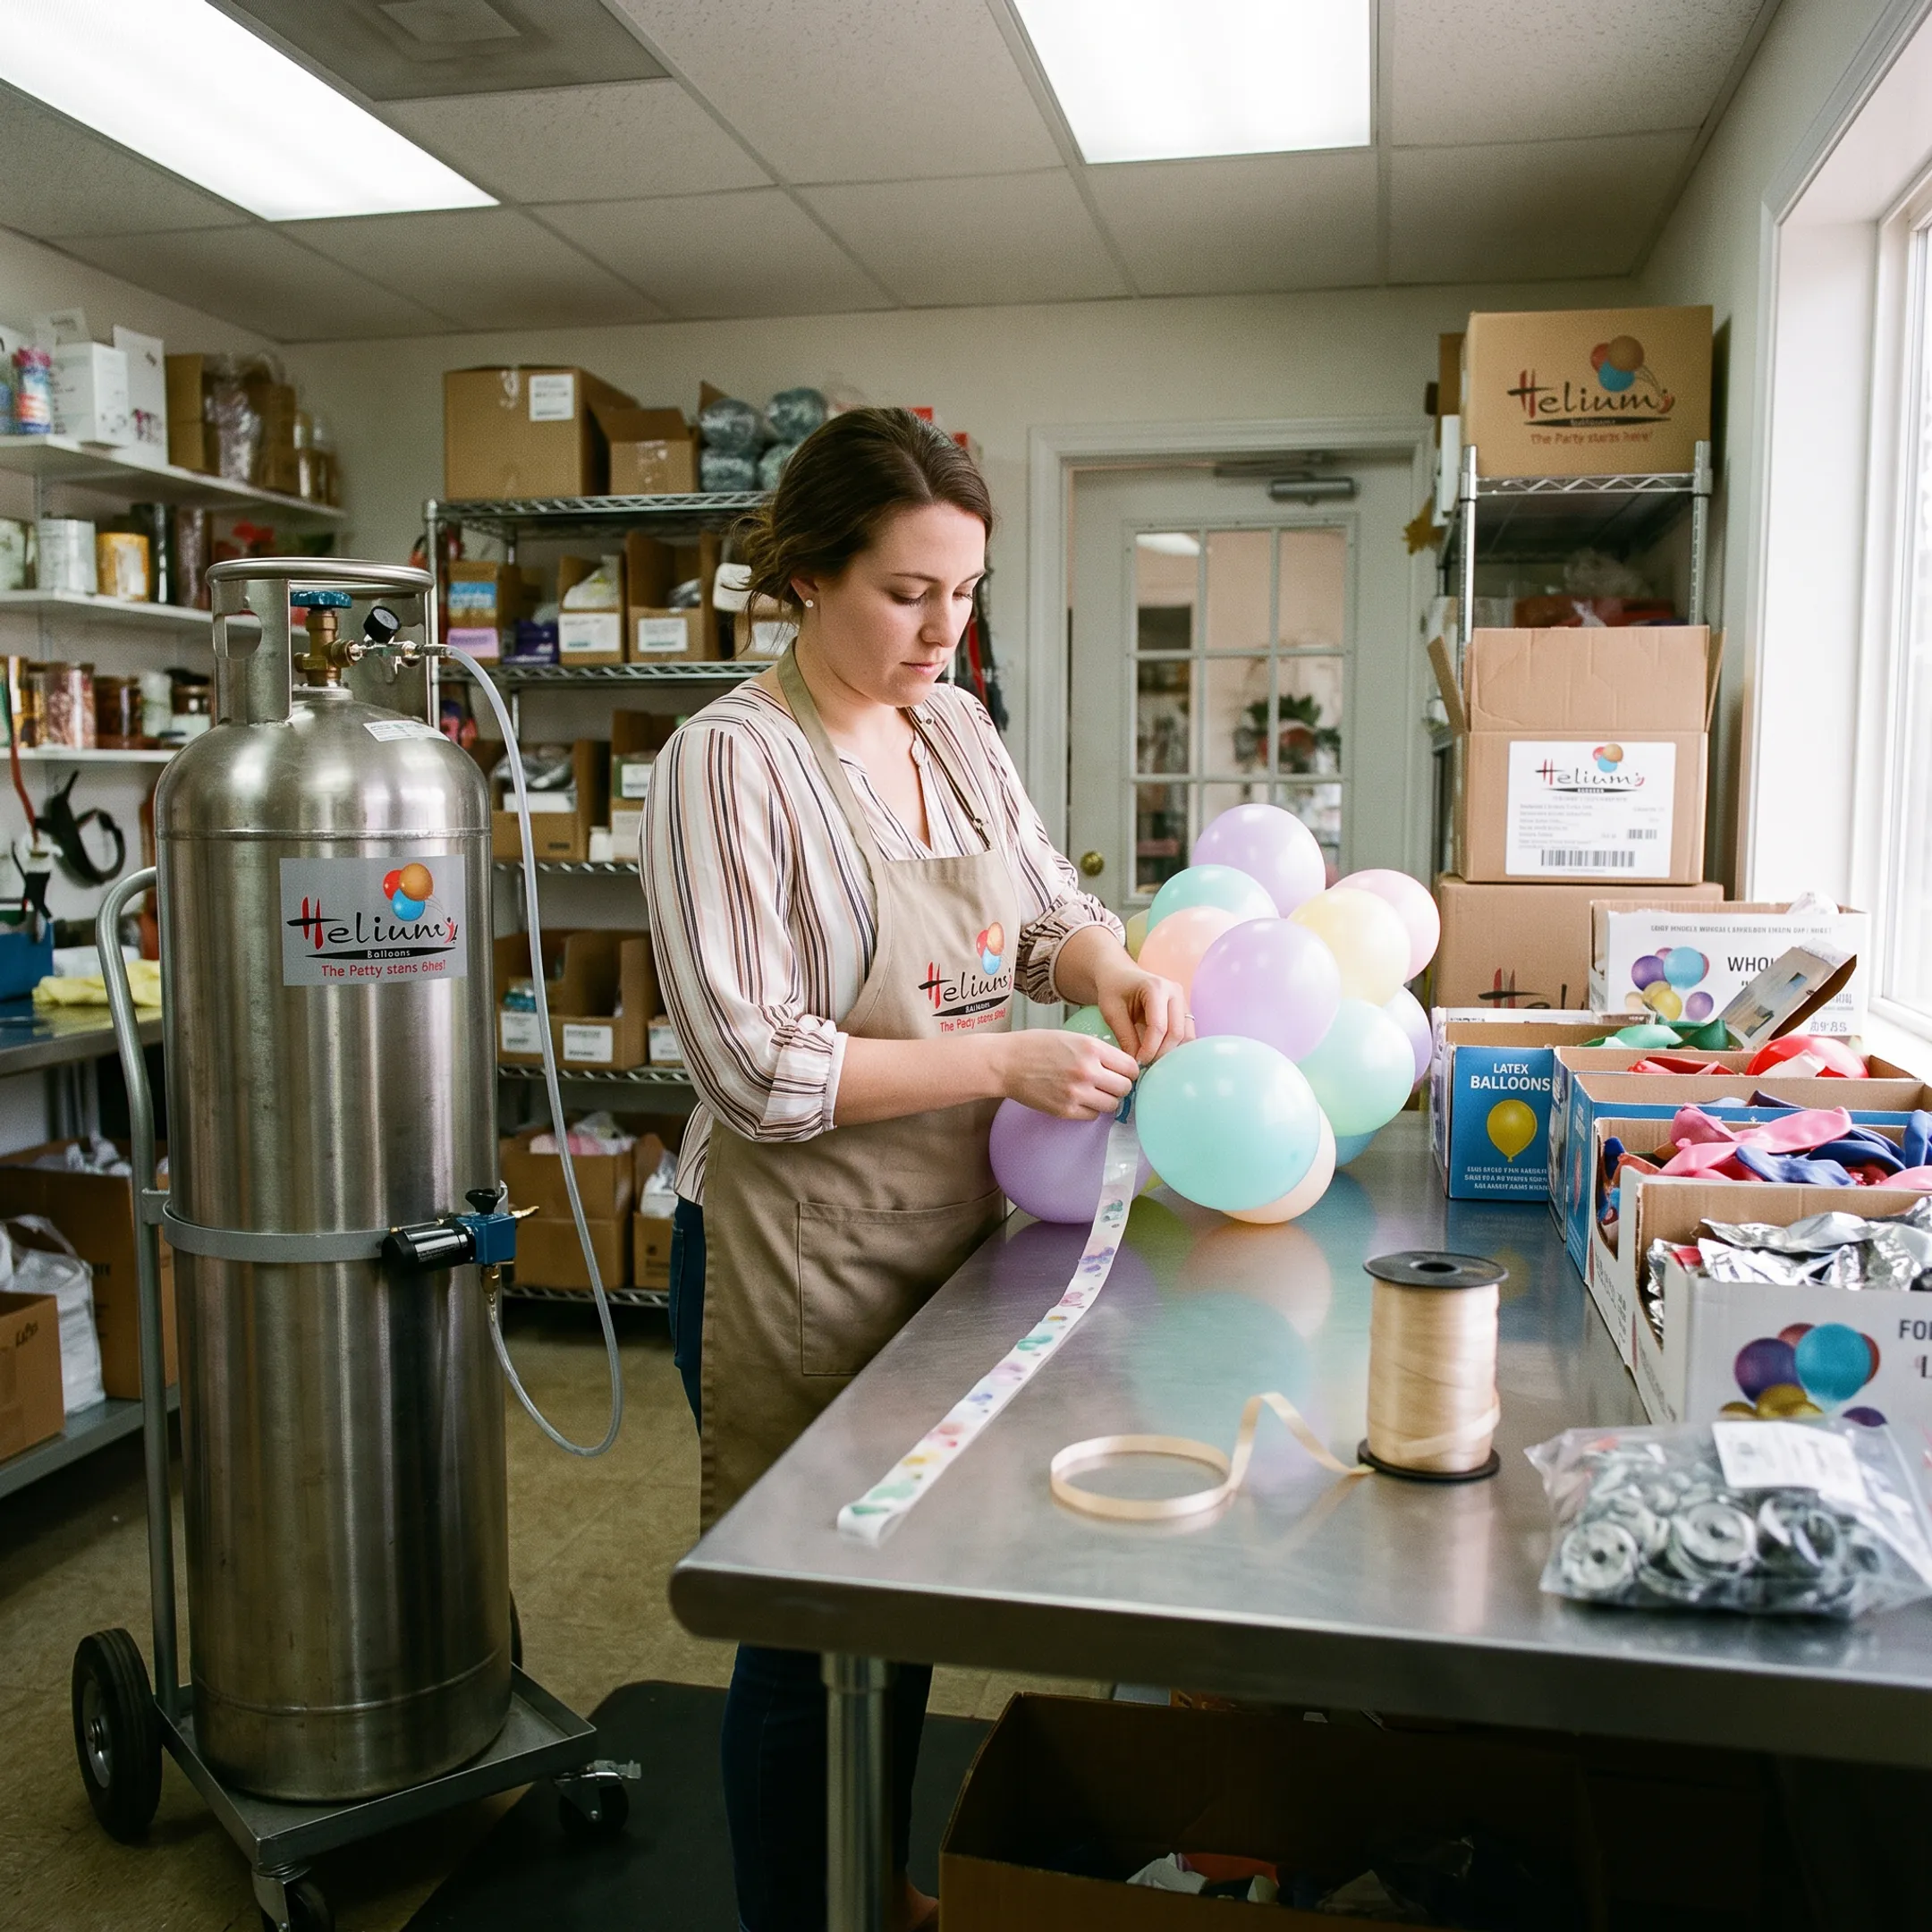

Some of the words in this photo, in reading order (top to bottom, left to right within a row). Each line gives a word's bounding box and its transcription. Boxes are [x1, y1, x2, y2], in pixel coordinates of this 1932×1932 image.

[367, 949, 411, 960] Balloons
[322, 965, 345, 977] The
[940, 1021, 954, 1032] The
[1493, 1063, 1529, 1075] LATEX
[1470, 1075, 1551, 1092] BALLOONS
